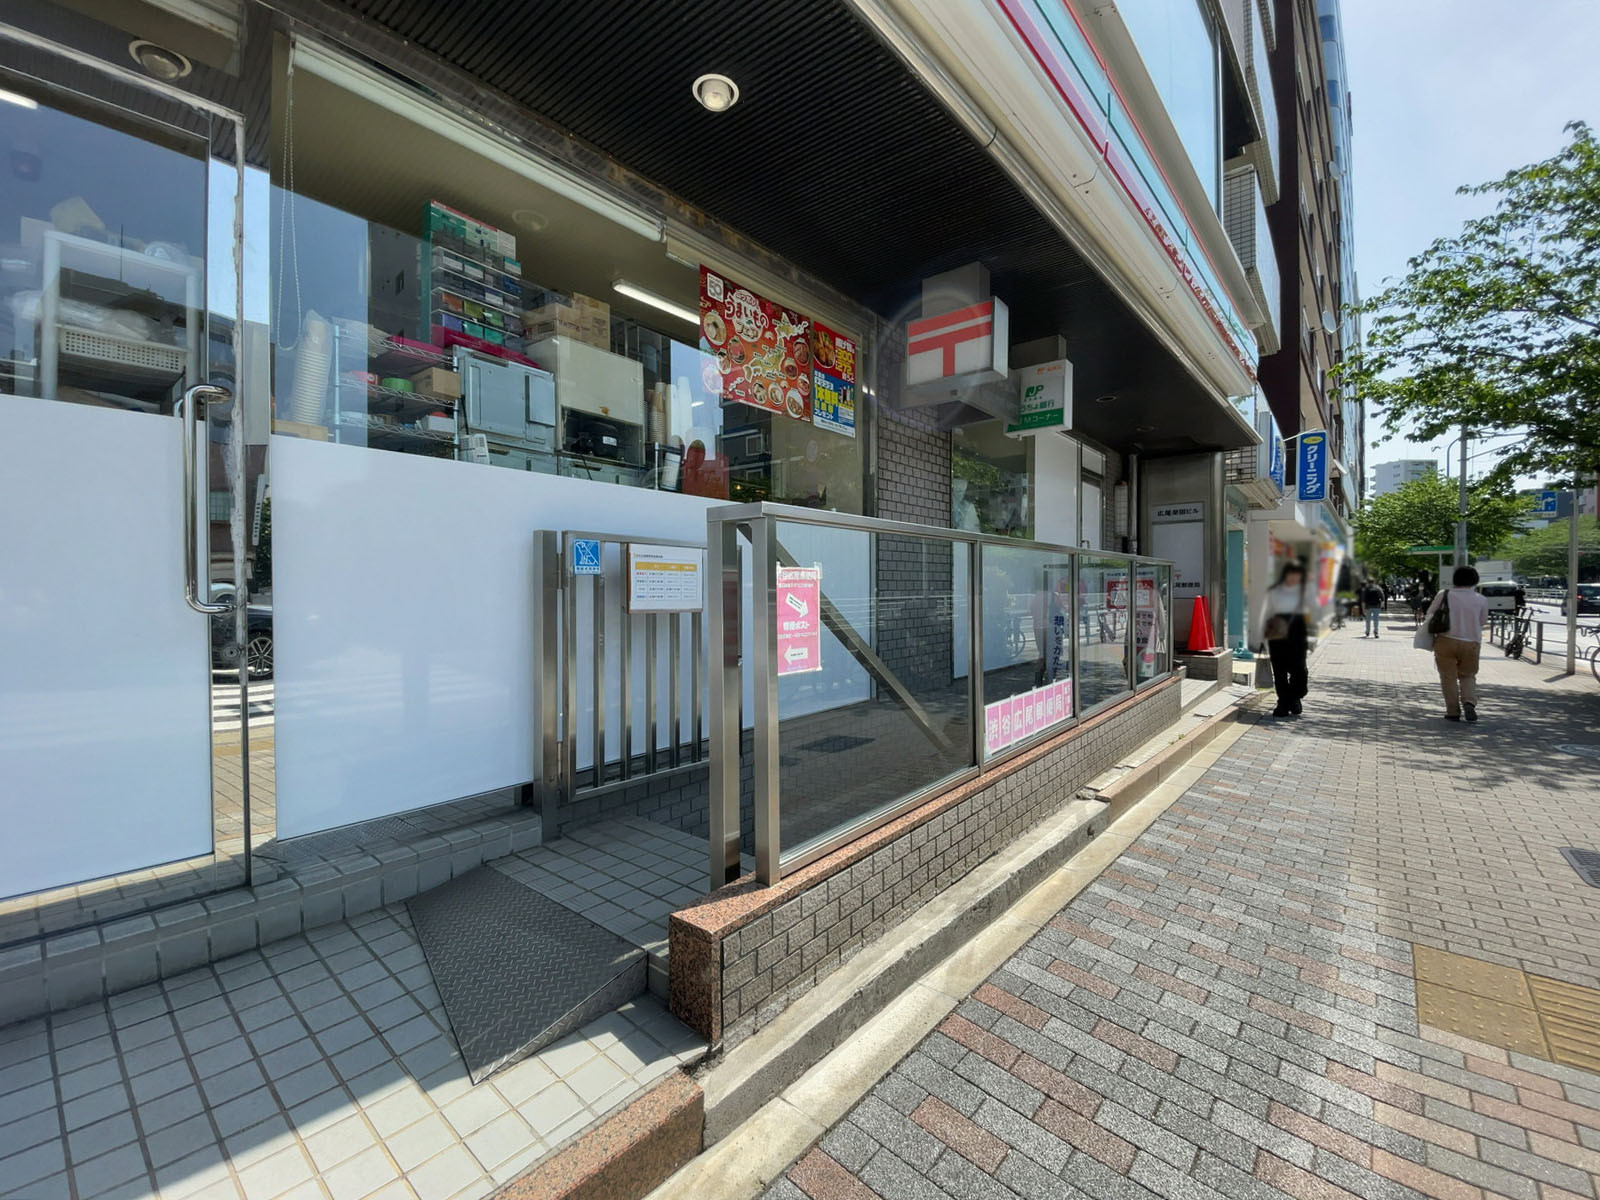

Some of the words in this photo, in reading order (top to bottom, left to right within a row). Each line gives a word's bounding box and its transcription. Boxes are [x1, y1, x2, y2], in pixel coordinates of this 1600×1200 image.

[726, 294, 769, 328] うまいもの
[1306, 445, 1320, 494] クリーニング
